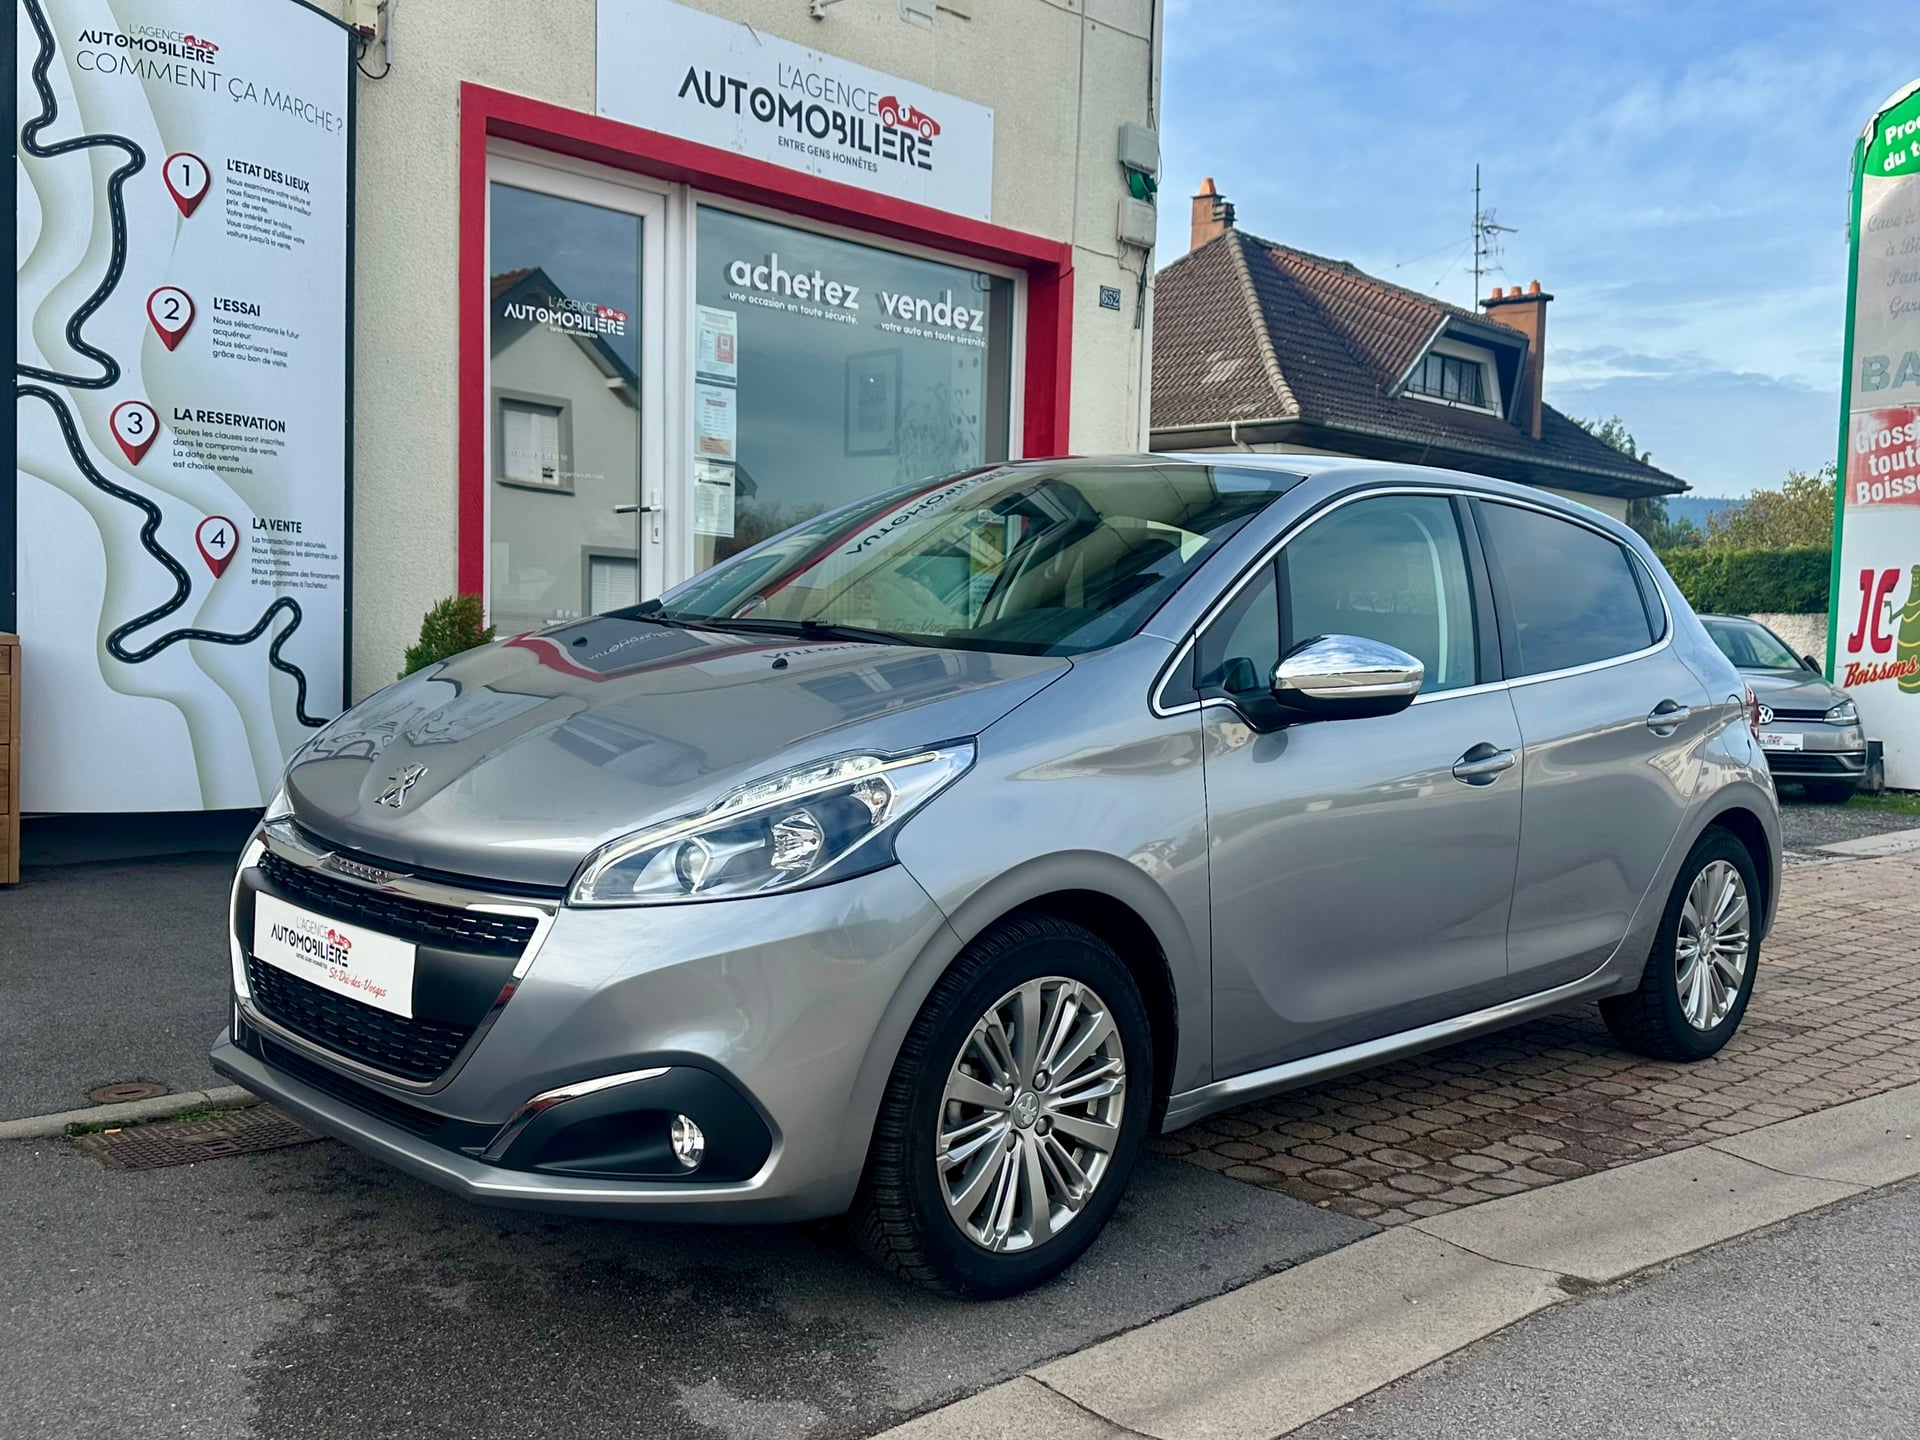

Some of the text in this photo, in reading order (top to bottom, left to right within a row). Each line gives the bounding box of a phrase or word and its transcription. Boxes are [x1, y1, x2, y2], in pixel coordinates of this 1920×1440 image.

[129, 23, 185, 47] L'AGENCE
[77, 50, 343, 136] COMMENT ÇA MARCHE ?
[778, 62, 879, 117] L'AGENCE
[778, 135, 878, 173] ENTRE GENS HONNÊTES
[1883, 140, 1920, 172] du t
[182, 163, 191, 188] 1
[226, 158, 310, 194] L'ETAT DES LIEUX
[226, 176, 243, 187] Nous
[276, 190, 290, 199] votre
[226, 188, 242, 197] nous
[243, 190, 261, 202] fixons
[226, 198, 239, 207] prix
[241, 201, 251, 209] de
[226, 208, 243, 218] Votre
[264, 218, 272, 226] est
[226, 218, 242, 229] Vous
[242, 223, 271, 235] continuez
[293, 235, 305, 245] votre
[226, 229, 248, 241] voiture
[270, 238, 277, 247] la
[730, 253, 985, 333] achetez vendez
[1102, 290, 1119, 306] 652
[164, 297, 180, 320] 2
[213, 297, 260, 317] L'ESSAI
[548, 295, 597, 315] L'AGENCE
[728, 291, 747, 302] une
[748, 295, 786, 311] occasion
[787, 303, 798, 312] en
[800, 305, 823, 318] toute
[212, 316, 233, 327] Nous
[234, 320, 279, 336] sélectionnons
[280, 328, 286, 336] le
[879, 321, 902, 335] votre
[903, 325, 922, 337] auto
[923, 330, 934, 339] en
[935, 331, 955, 343] toute
[212, 338, 233, 348] Nous
[233, 342, 269, 354] sécurisons
[212, 350, 235, 360] grâce
[236, 353, 246, 362] au
[248, 354, 261, 363] bon
[262, 357, 271, 366] de
[127, 411, 143, 435] 3
[174, 407, 286, 434] LA RESERVATION
[173, 427, 285, 448] Toutes les clauses sont inscrites
[173, 438, 194, 448] dans
[195, 439, 204, 449] le
[204, 442, 248, 454] compromis
[249, 445, 259, 455] de
[173, 448, 240, 464] La date de vente
[173, 460, 186, 470] est
[187, 461, 216, 472] choisie
[252, 517, 302, 534] LA VENTE
[211, 527, 226, 548] 4
[251, 535, 261, 544] La
[262, 537, 295, 547] transaction
[296, 539, 304, 547] est
[251, 546, 268, 555] Nous
[296, 549, 304, 557] les
[251, 567, 268, 577] Nous
[268, 569, 300, 579] proposons
[300, 570, 310, 579] des
[260, 579, 271, 587] des
[1847, 569, 1900, 654] JC
[1843, 654, 1919, 689] Boissons
[296, 916, 329, 940] L'AGENCE
